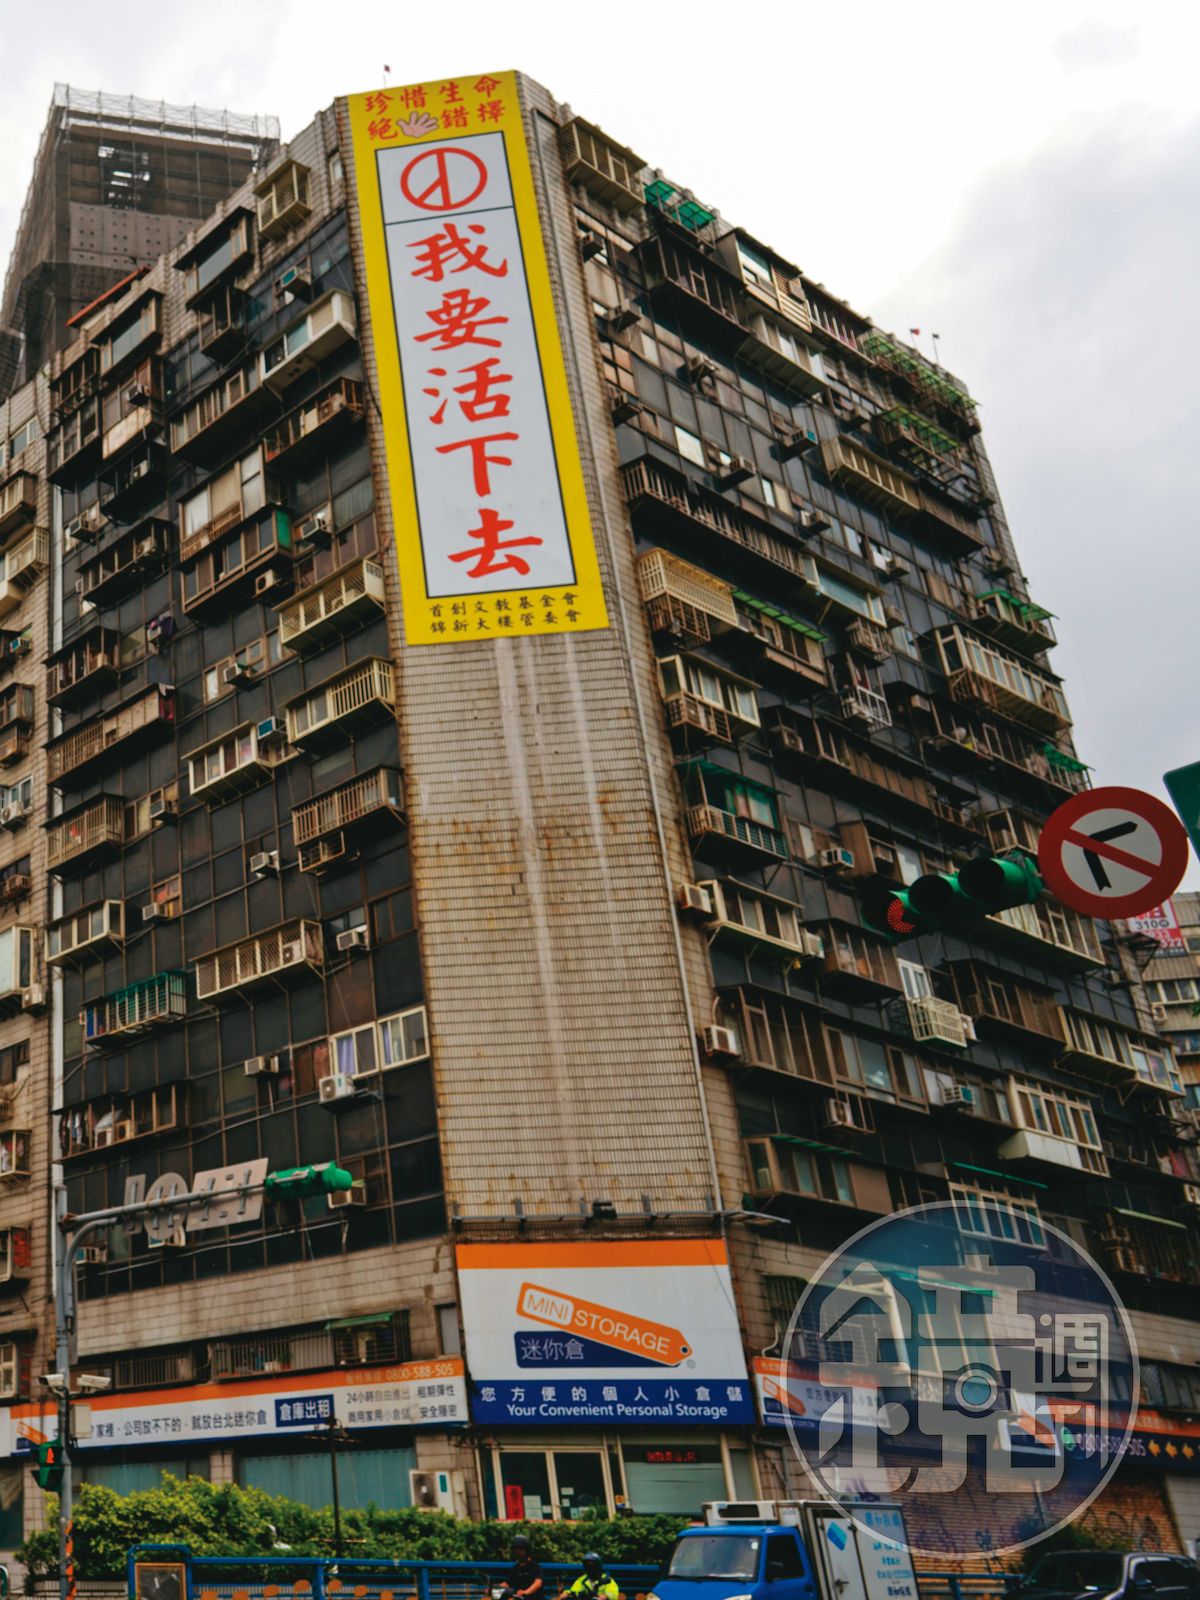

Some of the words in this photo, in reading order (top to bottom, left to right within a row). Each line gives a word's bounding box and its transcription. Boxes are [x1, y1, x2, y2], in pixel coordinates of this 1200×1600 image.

[365, 76, 502, 115] 珍惜生命
[405, 222, 543, 579] 我要活下去
[525, 1294, 570, 1321] MINI
[574, 1309, 671, 1355] STORAGE
[520, 1338, 585, 1361] 迷你倉
[480, 1386, 744, 1402] 您方便的個人小倉儲
[279, 1400, 331, 1421] 倉庫出租
[507, 1403, 536, 1416] Your
[539, 1403, 614, 1417] Convenient
[617, 1403, 673, 1416] Personal
[676, 1403, 728, 1419] Storage
